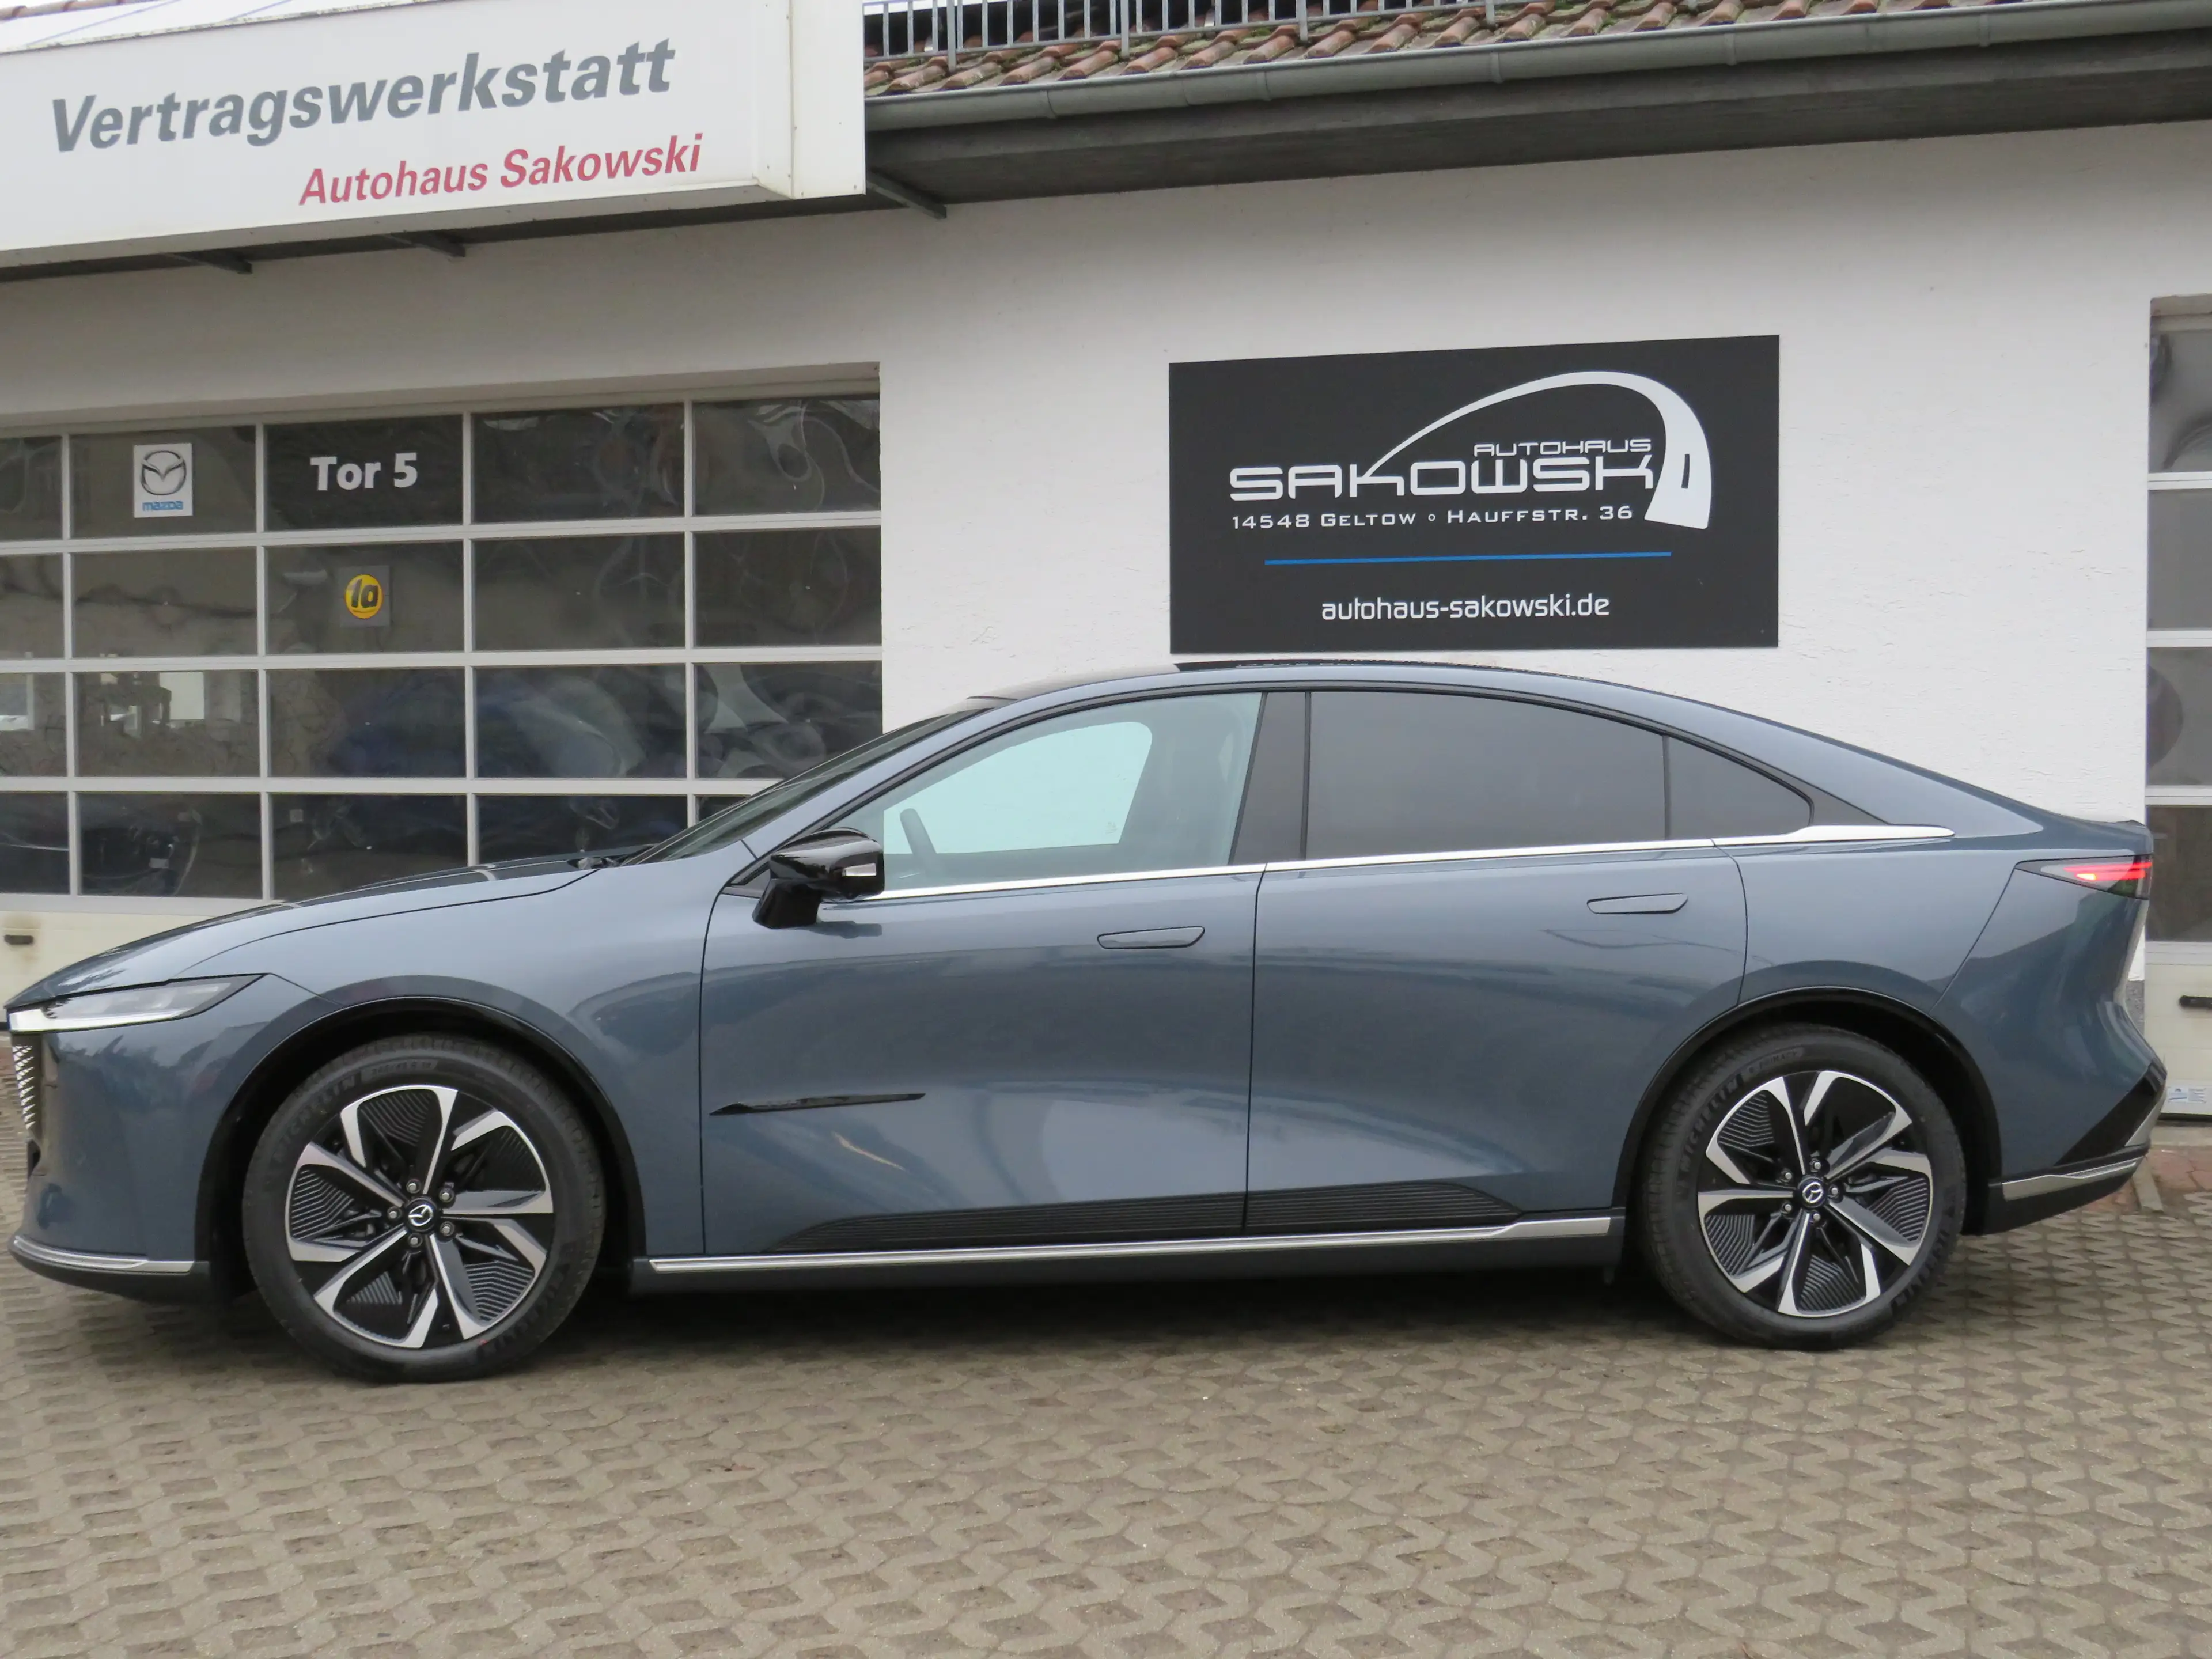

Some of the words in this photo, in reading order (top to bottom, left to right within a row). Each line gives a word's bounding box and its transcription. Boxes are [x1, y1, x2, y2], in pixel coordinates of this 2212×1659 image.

[52, 38, 676, 152] Vertragswerkstatt
[299, 161, 488, 204] Autohaus
[501, 133, 703, 187] Sakowski
[1474, 438, 1652, 457] AUTOHAUS
[311, 457, 381, 491] Tor
[395, 453, 417, 487] 5
[142, 501, 184, 511] mazda
[1232, 514, 1309, 529] 14548
[1599, 505, 1633, 520] 36
[1322, 593, 1609, 620] autohaus-sakowski.de
[1680, 1077, 1739, 1173] MICHELIN
